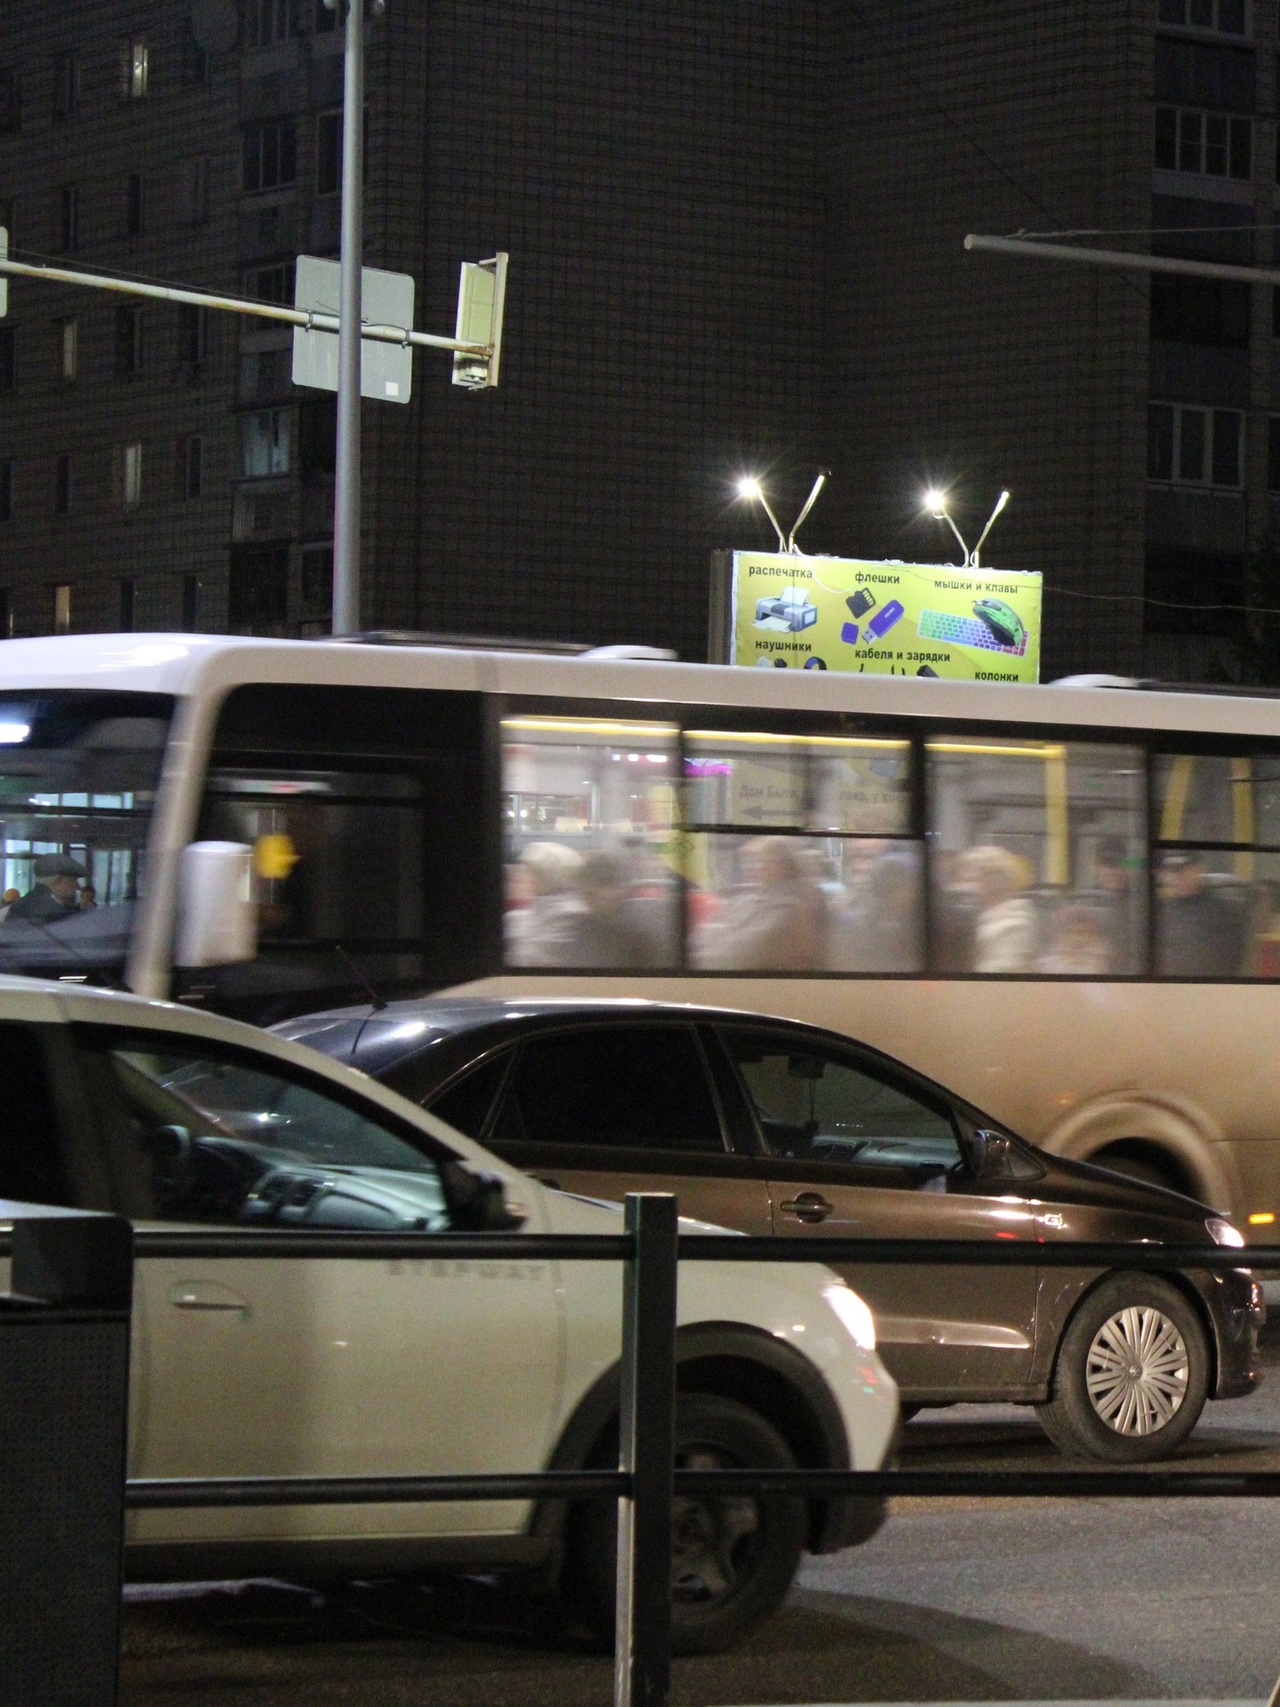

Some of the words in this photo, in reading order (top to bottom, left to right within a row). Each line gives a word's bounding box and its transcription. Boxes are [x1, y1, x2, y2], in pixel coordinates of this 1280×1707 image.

[749, 565, 813, 579] распечатка
[854, 571, 900, 584] флешки
[934, 580, 972, 590] мышки
[976, 583, 982, 591] и
[985, 583, 1018, 594] клавы
[755, 640, 812, 652] наушники
[855, 649, 893, 660] кабеля
[896, 651, 903, 660] и
[906, 652, 951, 663] зарядки
[974, 670, 1019, 682] колонки
